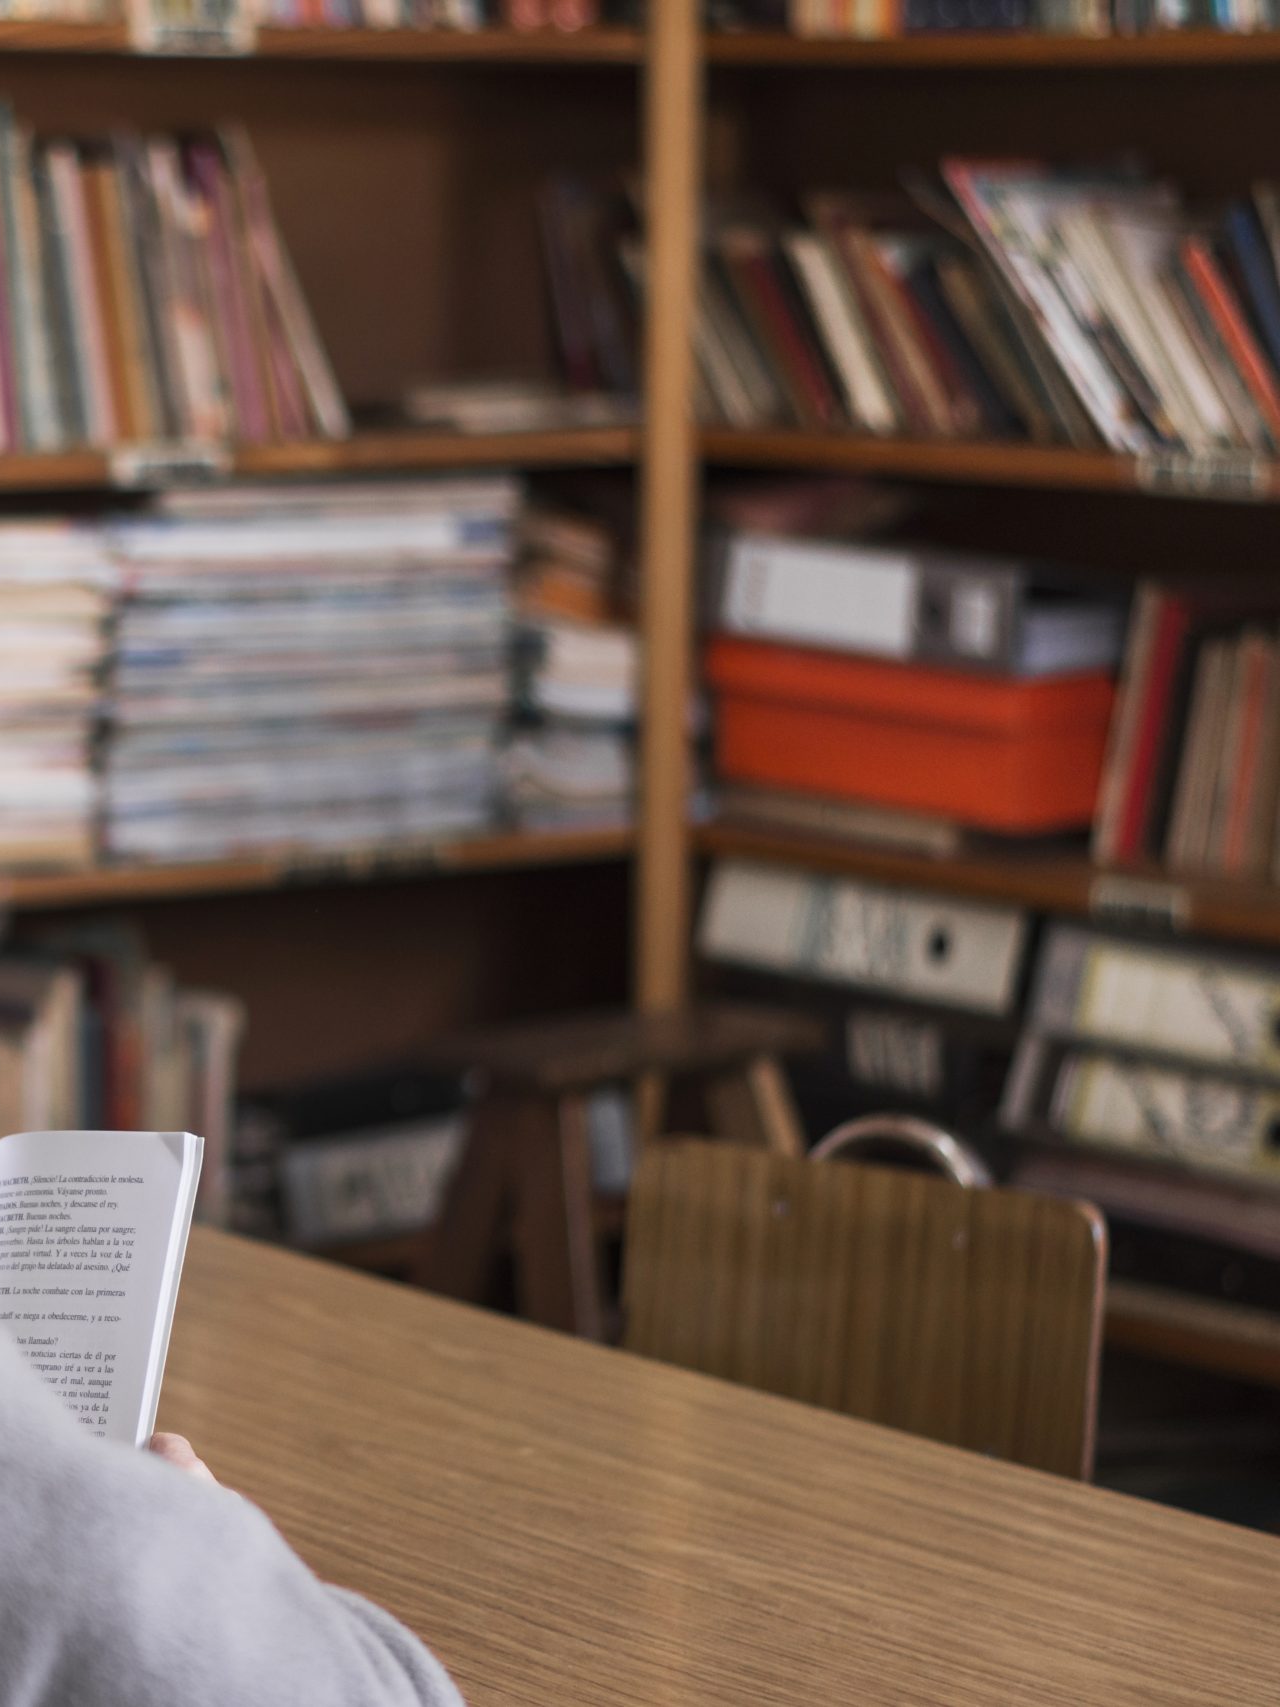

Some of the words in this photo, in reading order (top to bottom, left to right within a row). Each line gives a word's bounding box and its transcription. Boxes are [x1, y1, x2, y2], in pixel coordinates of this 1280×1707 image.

[59, 1174, 67, 1183] La
[67, 1174, 109, 1183] contradicción
[110, 1174, 118, 1183] le
[118, 1174, 145, 1184] molesta.
[57, 1187, 83, 1197] Váyanse
[70, 1200, 99, 1208] descanse
[99, 1200, 107, 1208] el
[48, 1211, 72, 1220] noches.
[44, 1224, 53, 1233] La
[55, 1226, 76, 1235] sangre
[77, 1224, 97, 1233] clama
[98, 1226, 111, 1235] por
[26, 1237, 44, 1245] Hasta
[45, 1237, 55, 1245] los
[56, 1236, 80, 1245] árboles
[82, 1237, 105, 1246] hablan
[113, 1238, 120, 1246] la
[90, 1250, 97, 1258] la
[114, 1250, 123, 1259] de
[125, 1251, 132, 1259] la
[11, 1262, 20, 1270] del
[20, 1263, 36, 1272] grajo
[37, 1262, 45, 1270] ha
[47, 1261, 74, 1270] delatado
[75, 1262, 83, 1270] al
[111, 1263, 130, 1273] ¿Qué
[12, 1286, 20, 1295] La
[22, 1287, 40, 1295] noche
[42, 1286, 69, 1295] combate
[85, 1287, 95, 1296] las
[96, 1289, 126, 1298] primeras
[23, 1312, 40, 1322] niega
[47, 1312, 89, 1322] obedecerme,
[28, 1336, 59, 1346] llamado?
[30, 1350, 57, 1358] noticias
[59, 1350, 82, 1359] ciertas
[84, 1352, 93, 1360] de
[95, 1351, 102, 1360] él
[104, 1354, 116, 1363] por
[64, 1363, 74, 1372] iré
[104, 1365, 114, 1373] las
[60, 1376, 68, 1384] el
[88, 1379, 113, 1388] aunque
[79, 1389, 111, 1399] voluntad.
[80, 1404, 89, 1413] ya
[91, 1403, 100, 1412] de
[102, 1403, 109, 1412] la
[98, 1416, 107, 1425] Es
